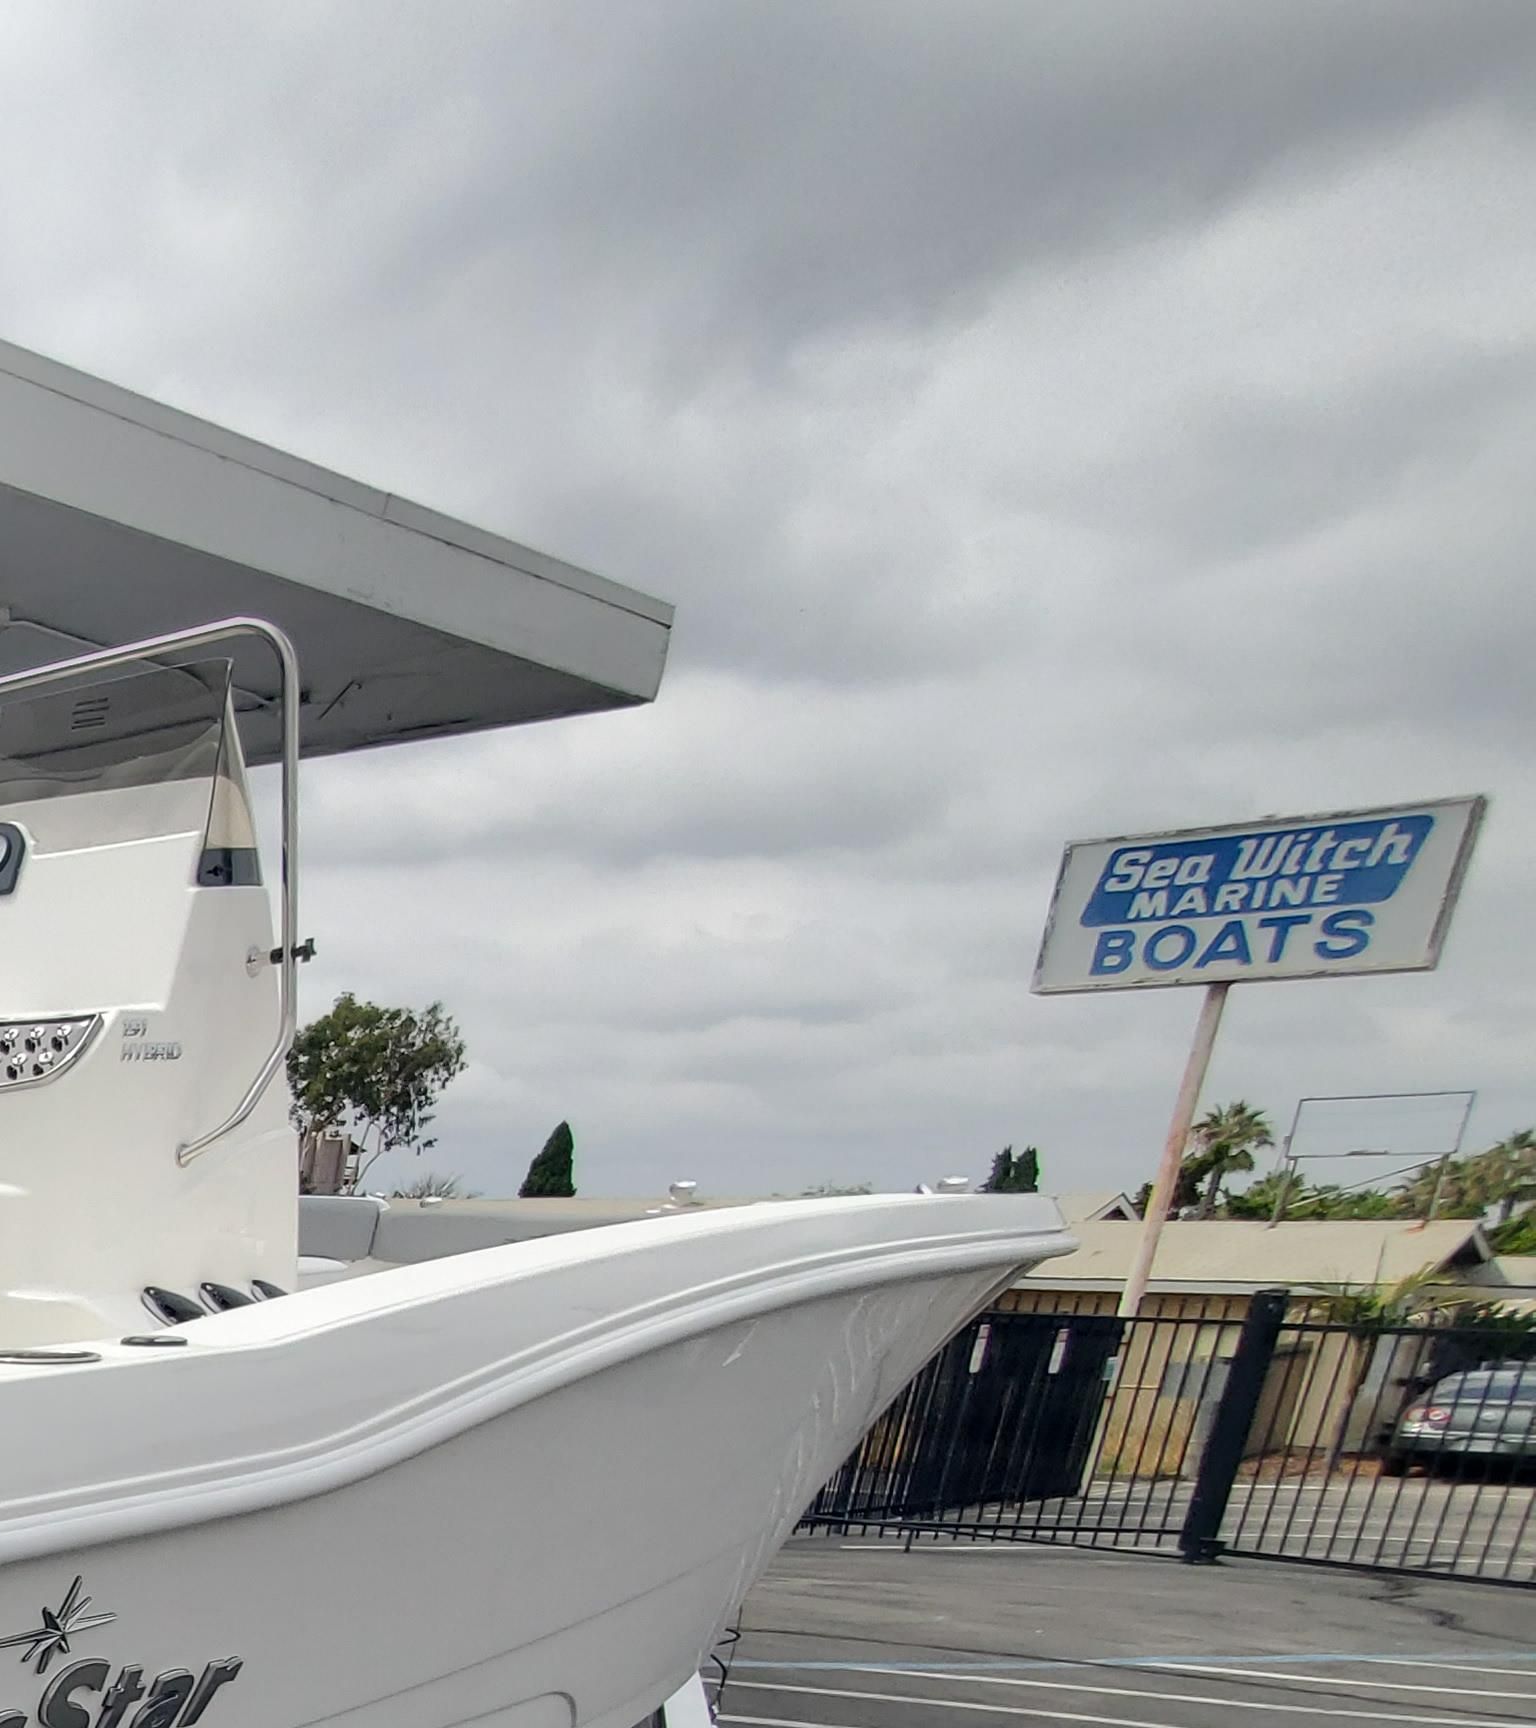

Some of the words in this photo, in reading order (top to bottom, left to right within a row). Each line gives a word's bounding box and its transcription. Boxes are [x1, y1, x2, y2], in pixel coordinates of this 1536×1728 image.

[1104, 849, 1215, 893] Sea
[1229, 822, 1413, 881] Witch
[1128, 873, 1345, 920] MARINE
[1089, 908, 1377, 976] BOATS
